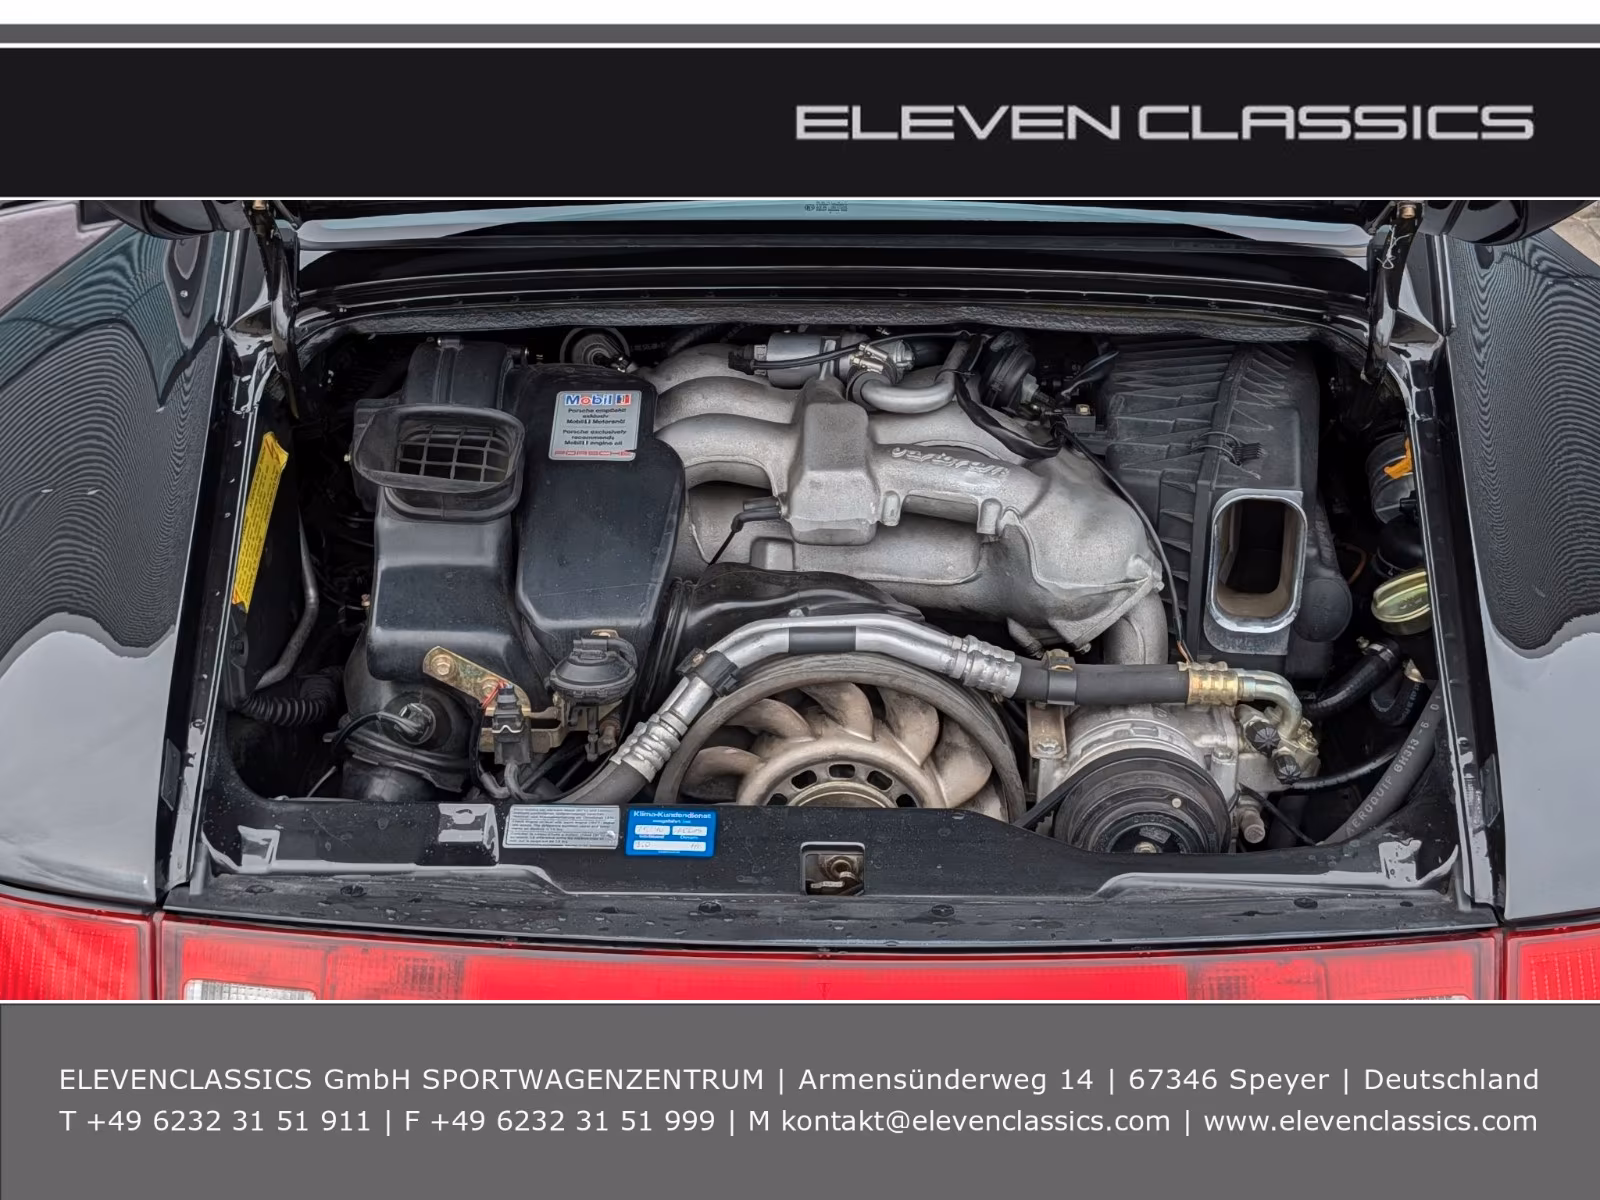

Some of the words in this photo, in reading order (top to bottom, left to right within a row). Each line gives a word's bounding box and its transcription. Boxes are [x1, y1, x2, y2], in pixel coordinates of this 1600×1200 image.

[565, 394, 613, 406] Mobil
[1345, 775, 1393, 838] AEROQUIP
[633, 810, 712, 819] Klima-Kundendienst
